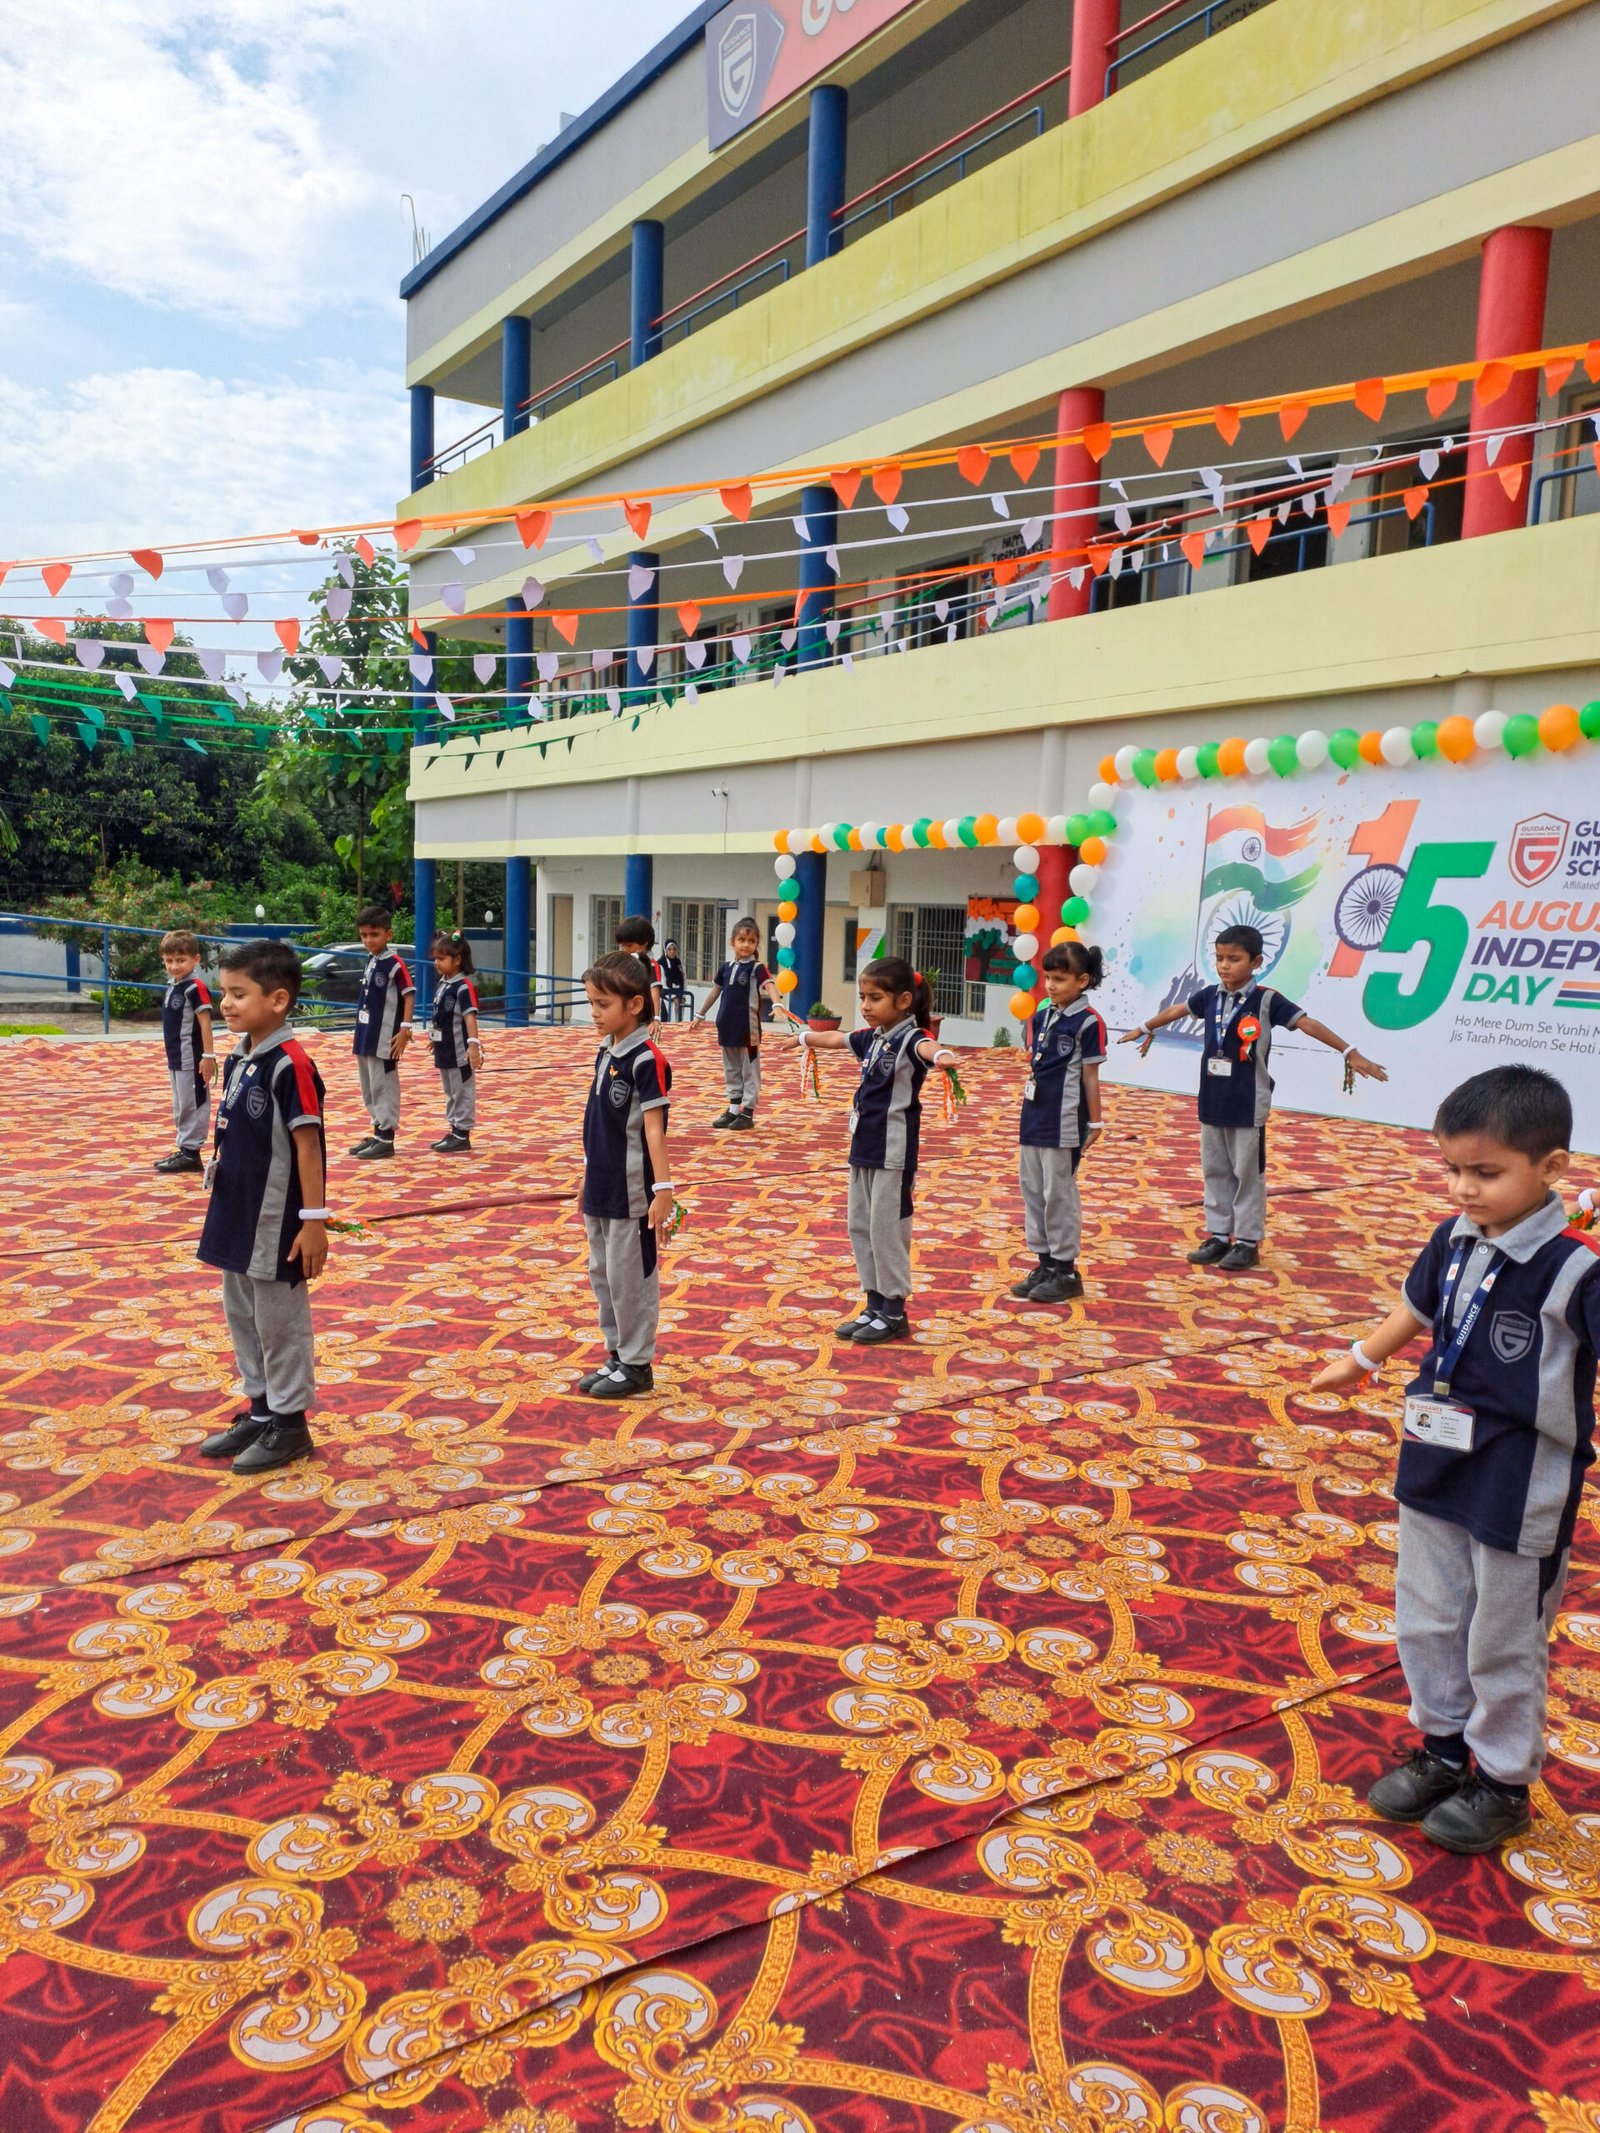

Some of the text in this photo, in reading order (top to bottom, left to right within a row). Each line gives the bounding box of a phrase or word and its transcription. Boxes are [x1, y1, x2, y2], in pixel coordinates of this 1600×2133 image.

[802, 0, 857, 36] G
[723, 38, 753, 108] G
[1515, 837, 1560, 881] G
[1563, 880, 1600, 890] Affiliated
[1476, 900, 1600, 932] AUGU
[1463, 973, 1555, 1006] DAY
[1449, 1029, 1596, 1054] Jis Tarah Phoolon Se Hoti
[1454, 1015, 1471, 1027] Ho
[1473, 1016, 1503, 1030] Mere
[1505, 1018, 1534, 1032] Dum
[1536, 1021, 1553, 1034] Se
[1556, 1022, 1590, 1037] Yunhi
[1456, 1302, 1479, 1346] GUIDANCE
[1494, 1323, 1530, 1358] G
